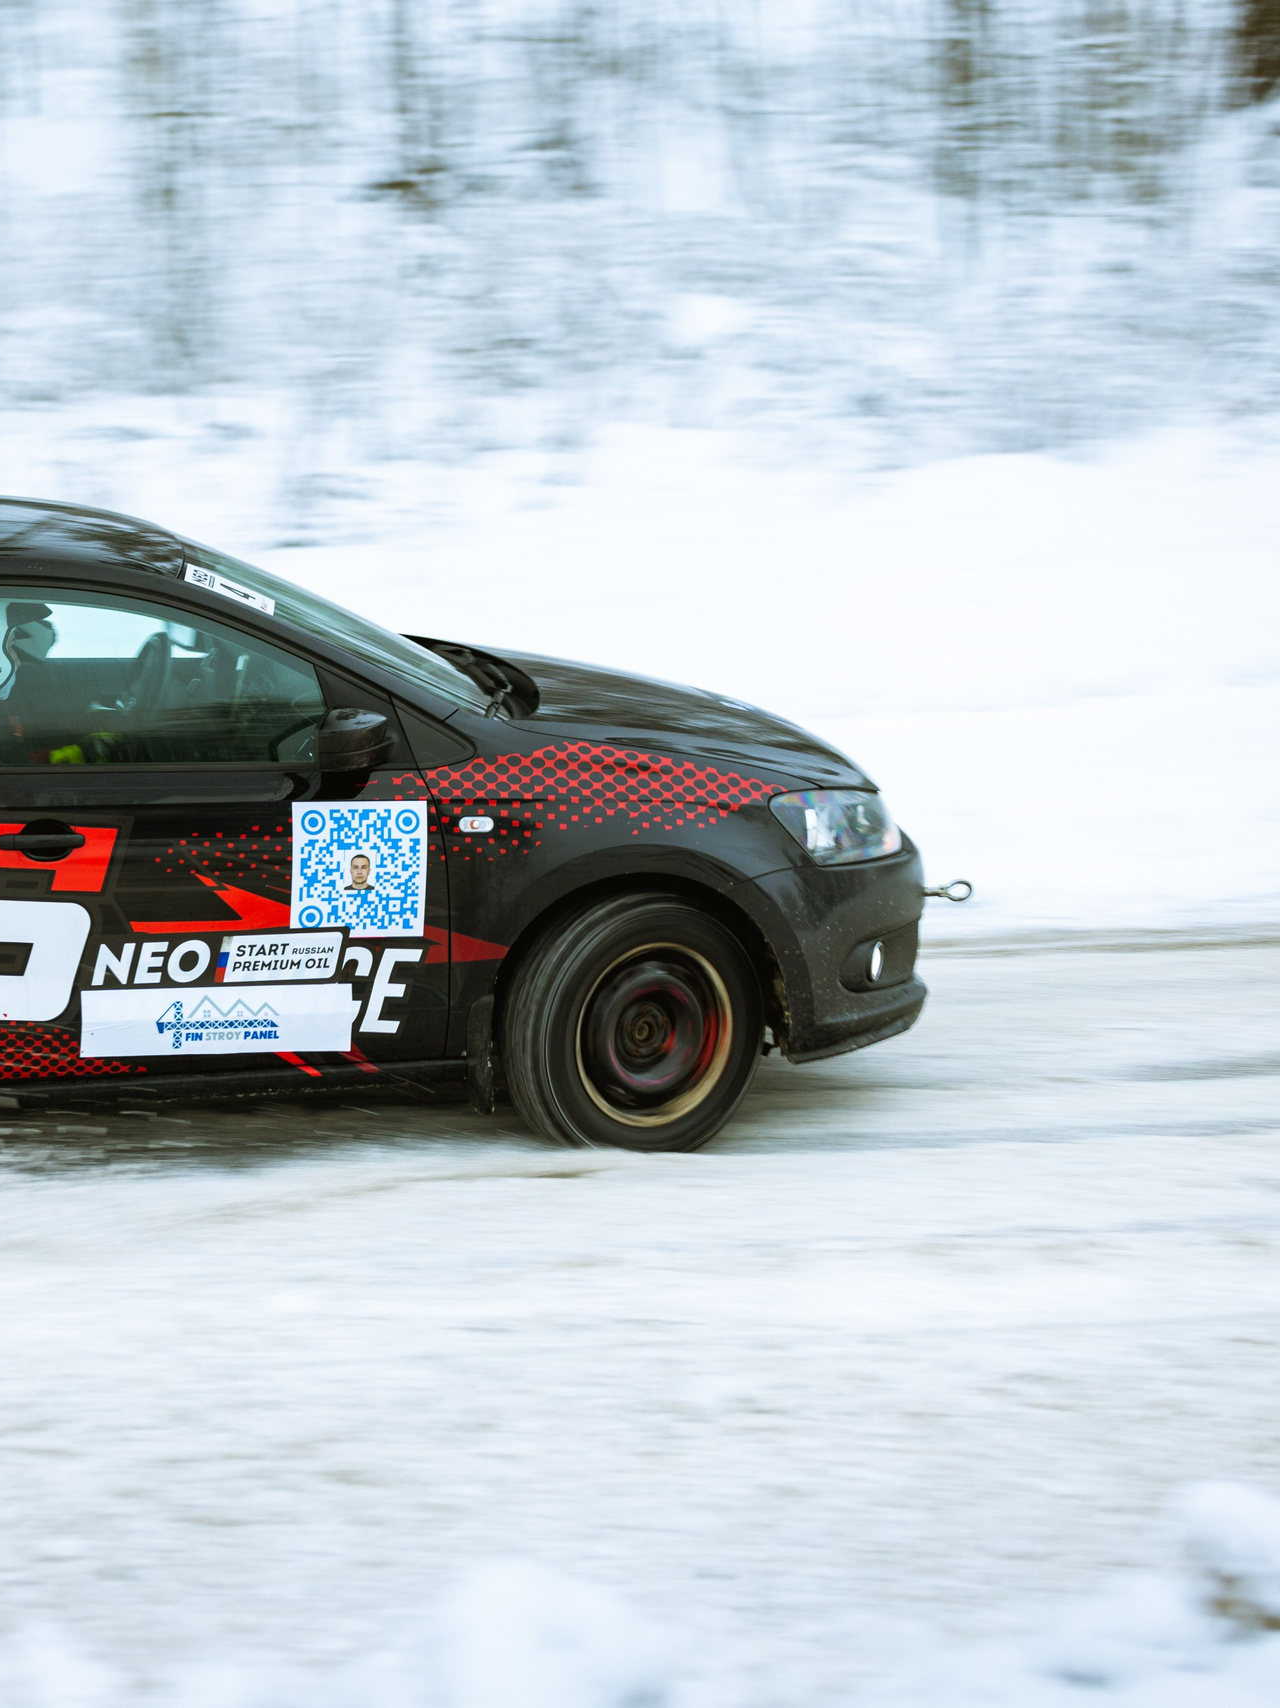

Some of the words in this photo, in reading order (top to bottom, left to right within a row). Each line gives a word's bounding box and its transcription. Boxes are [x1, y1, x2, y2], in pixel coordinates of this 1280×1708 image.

[236, 943, 289, 957] START
[292, 946, 334, 955] RUSSIAN
[91, 939, 211, 986] NEO
[232, 960, 301, 972] PREMIUM
[305, 958, 330, 969] OIL
[185, 1032, 203, 1041] FIN
[205, 1031, 242, 1041] STROY
[243, 1030, 279, 1040] PANEL
